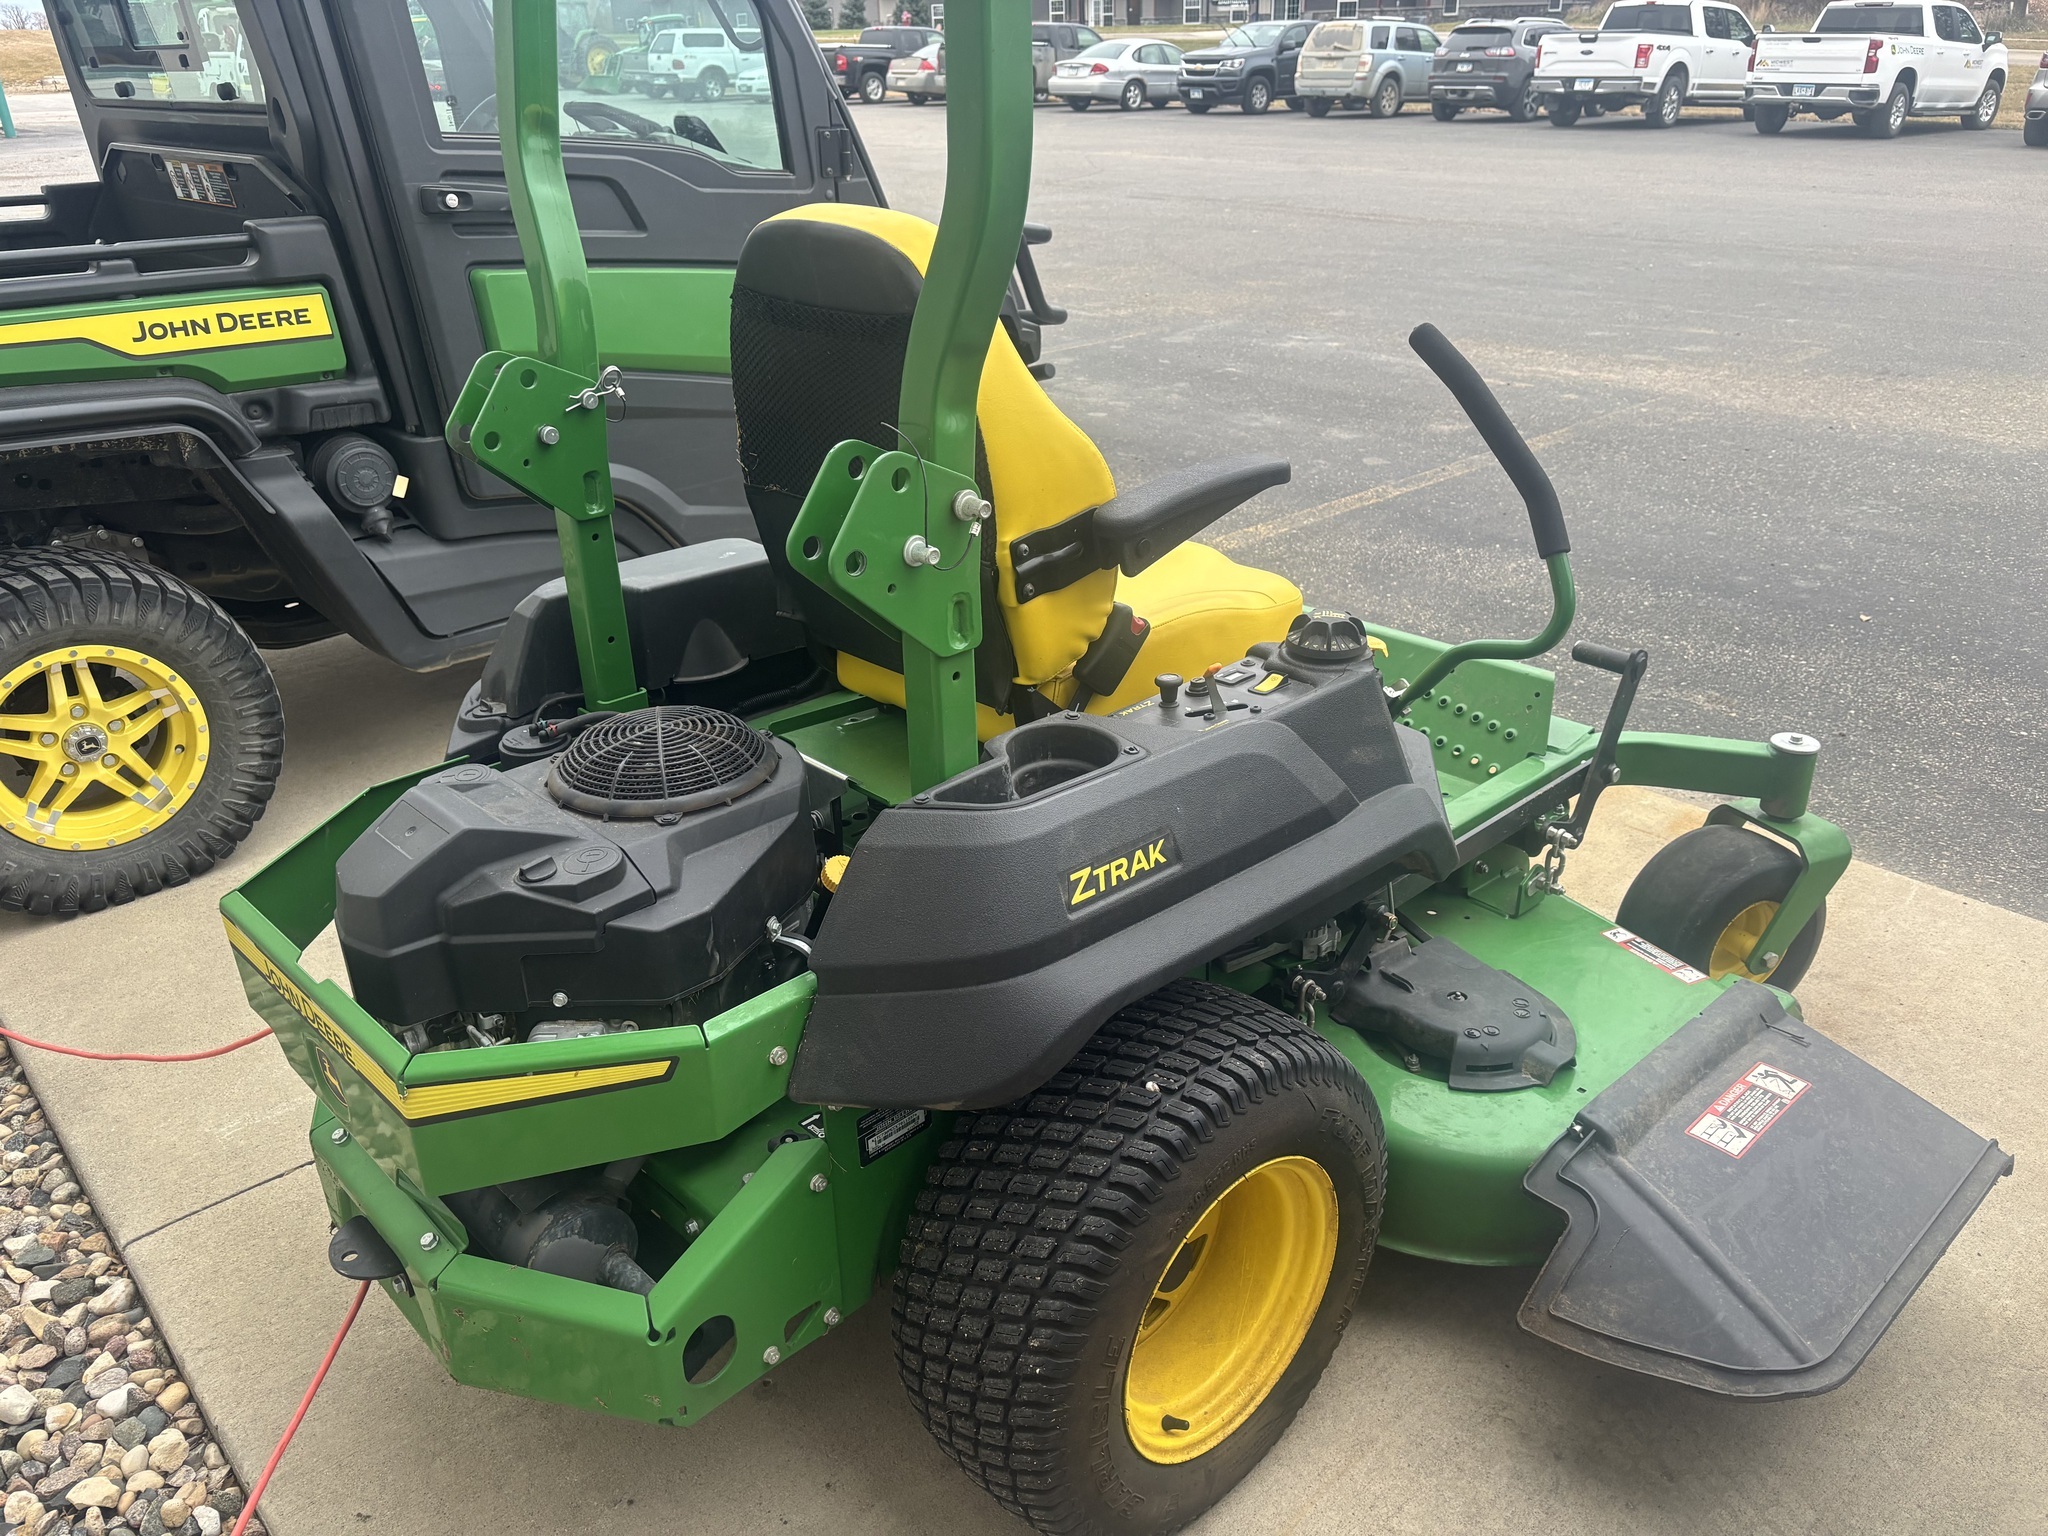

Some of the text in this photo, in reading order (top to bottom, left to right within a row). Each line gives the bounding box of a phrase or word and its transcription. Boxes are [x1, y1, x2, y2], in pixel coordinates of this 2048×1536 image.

[1897, 44, 1925, 55] JOHN DEERE
[132, 308, 311, 342] JOHN DEERE
[1069, 839, 1167, 905] ZTRAK
[264, 959, 355, 1065] JOHN DEERE
[1720, 1083, 1747, 1109] DANGER
[1320, 1107, 1372, 1159] TURF
[1089, 1335, 1145, 1520] CARLISLE
